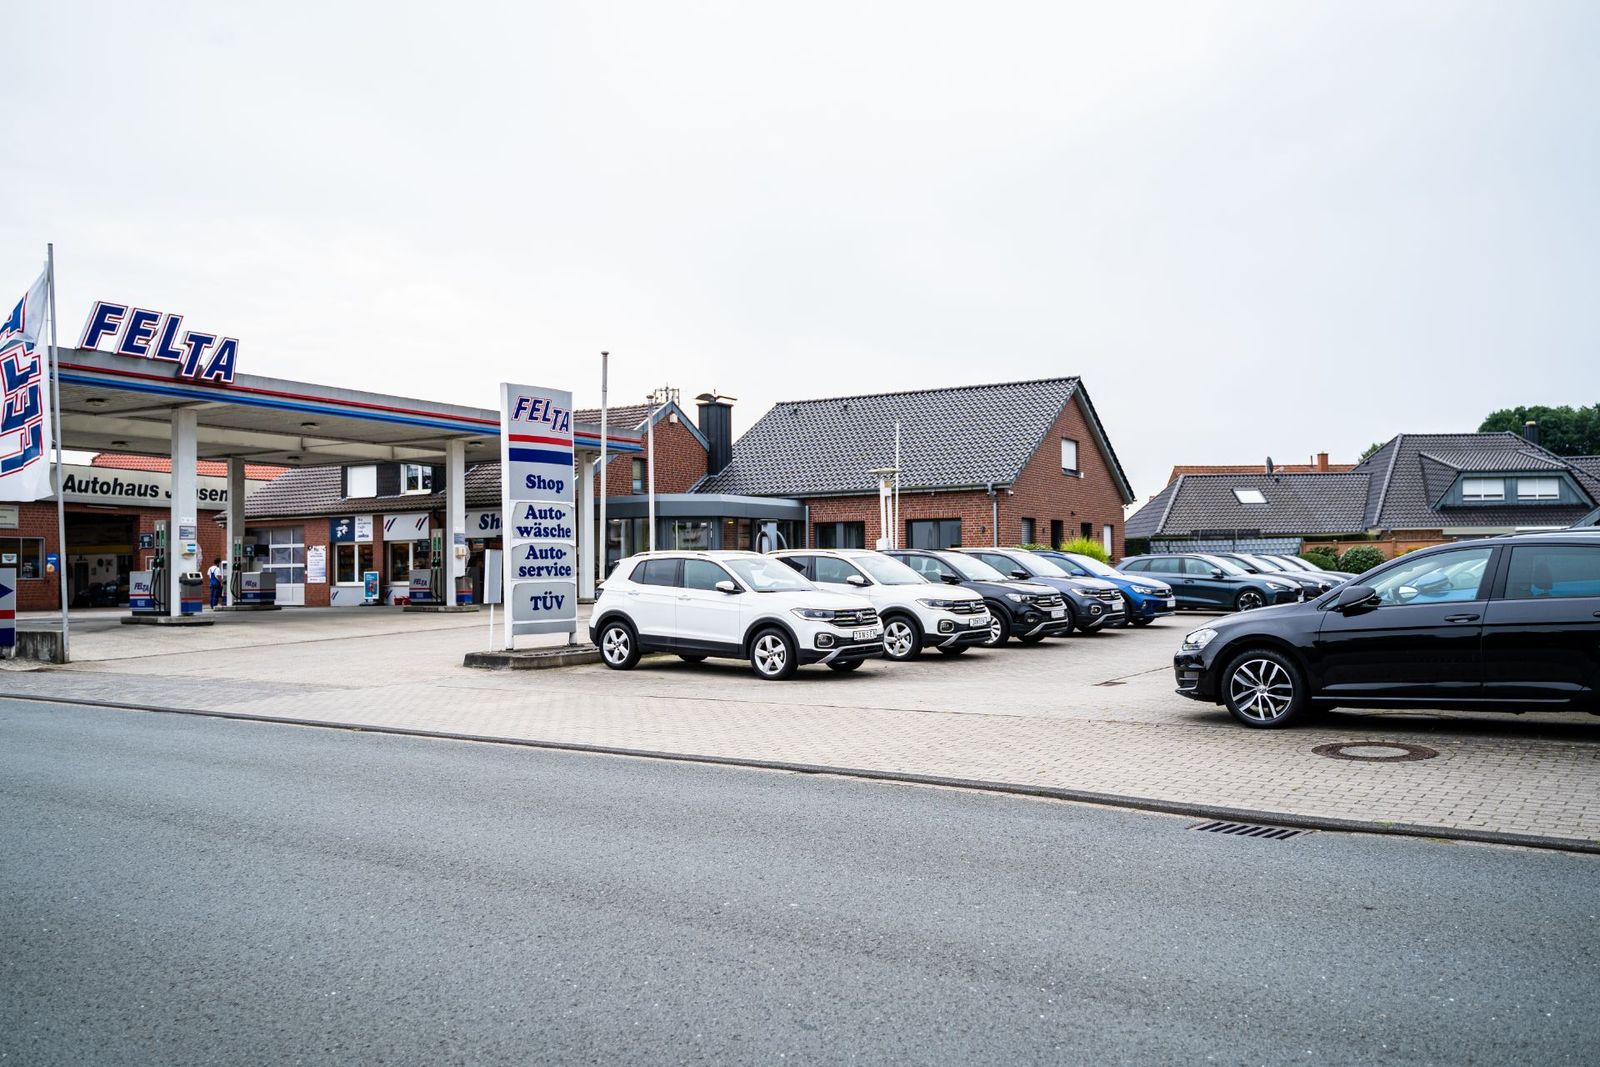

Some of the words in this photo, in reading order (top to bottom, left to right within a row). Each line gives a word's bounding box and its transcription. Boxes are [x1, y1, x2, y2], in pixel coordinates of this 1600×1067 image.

[80, 301, 239, 384] FELTA
[512, 396, 570, 433] FELTA
[63, 474, 159, 498] Autohaus
[525, 474, 564, 493] Shop
[479, 513, 502, 530] Sh
[524, 504, 566, 521] Auto-
[516, 522, 571, 538] wäsche
[525, 545, 567, 560] Auto-
[518, 562, 571, 578] service
[530, 591, 564, 611] TÜV
